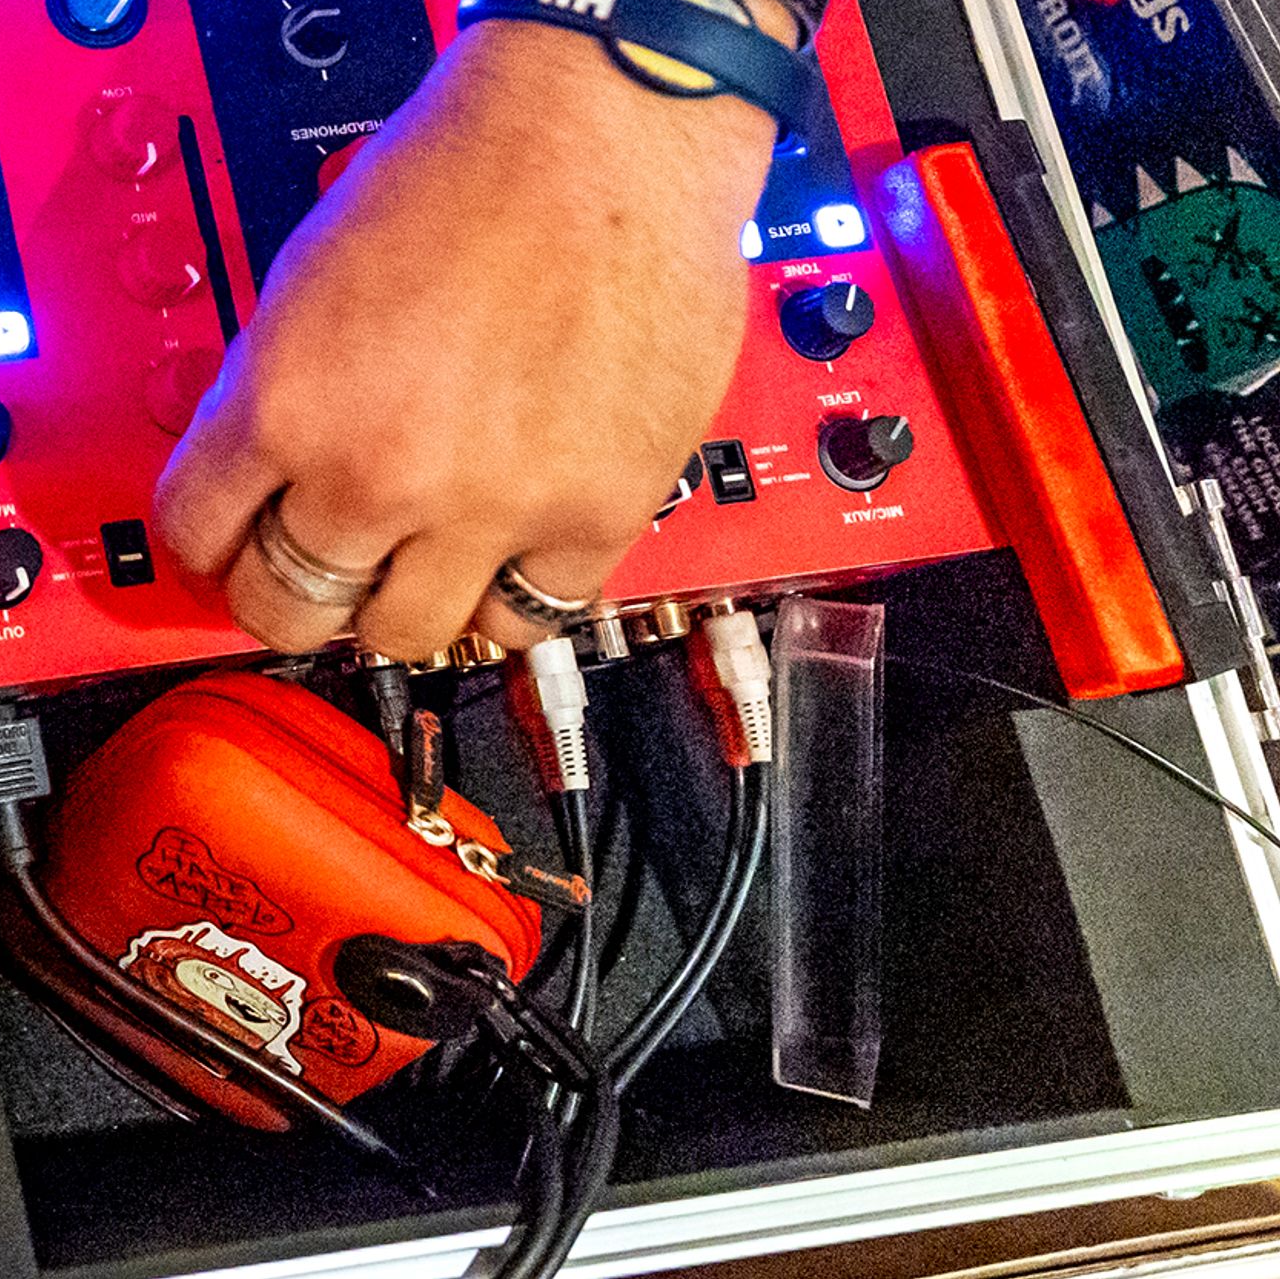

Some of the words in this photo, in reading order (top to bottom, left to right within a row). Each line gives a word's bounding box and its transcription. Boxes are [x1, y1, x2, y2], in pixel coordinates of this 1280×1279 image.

[101, 86, 133, 98] LOW
[130, 211, 157, 224] MID
[767, 222, 812, 239] BEATS
[781, 262, 822, 278] TONE
[817, 390, 862, 408] LEVEL
[842, 504, 905, 524] MIC/AUX
